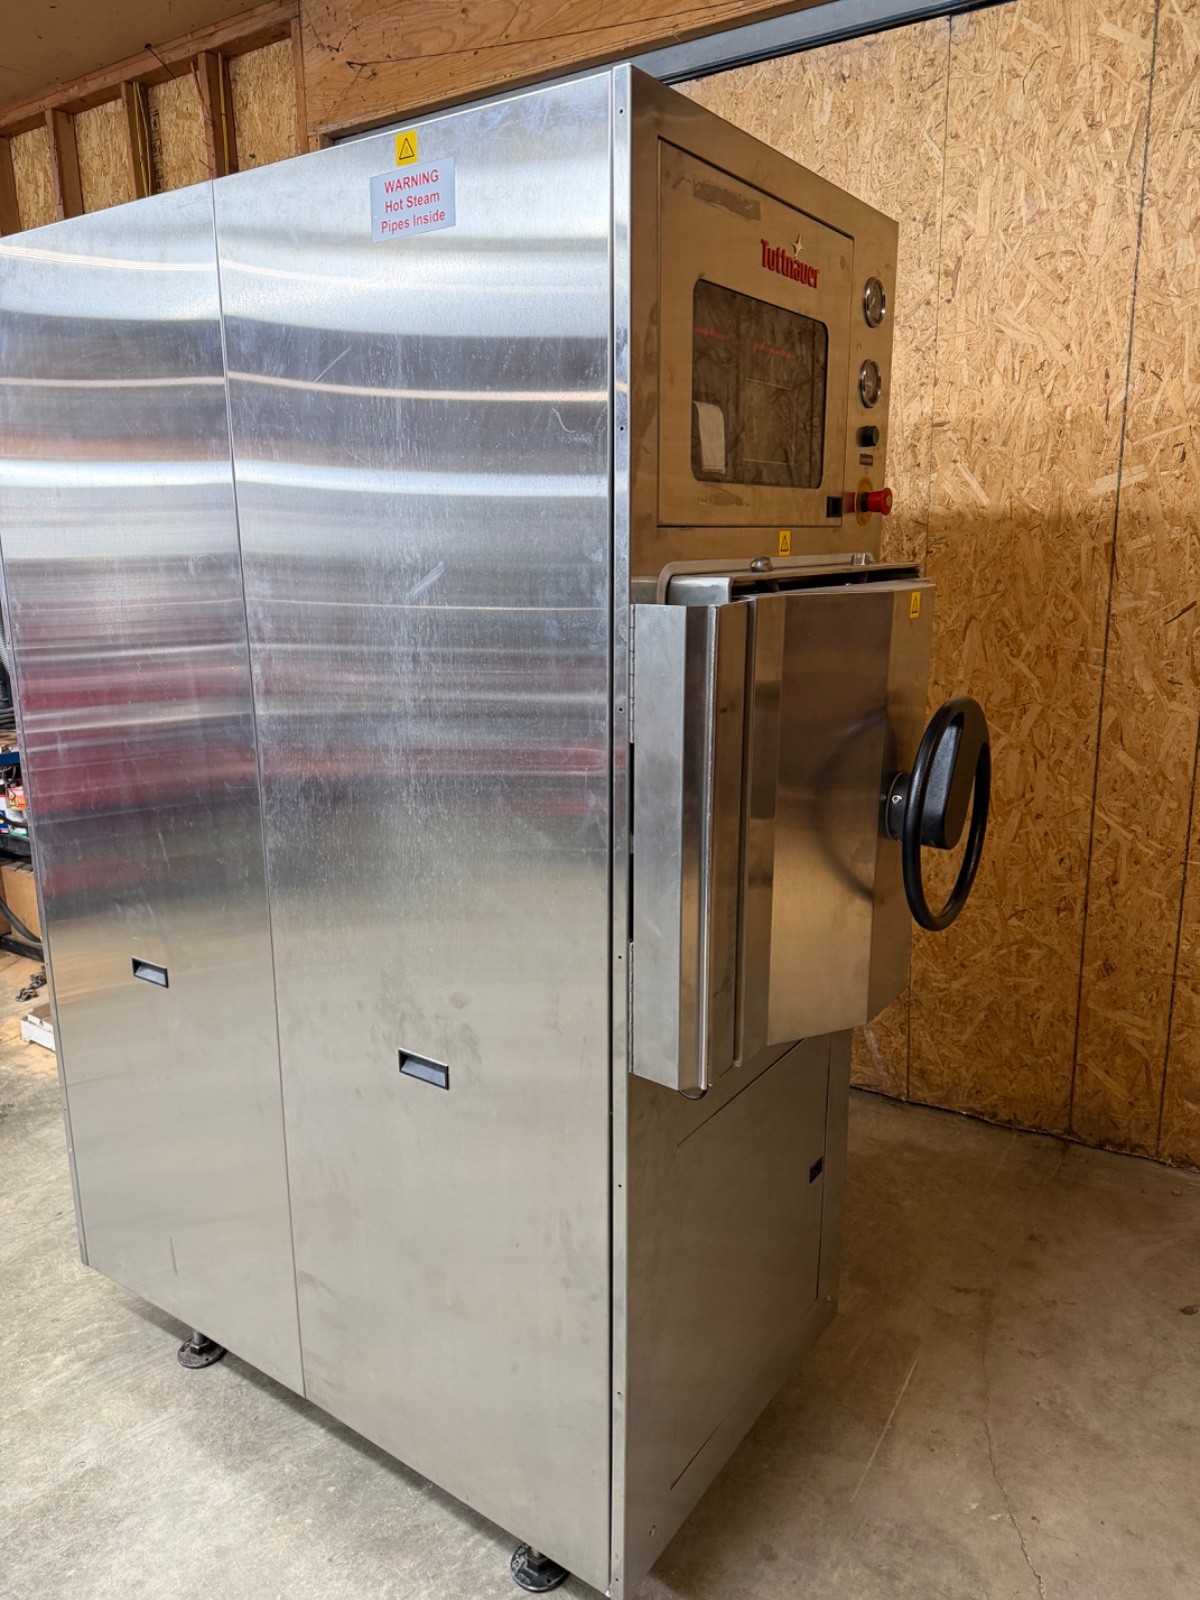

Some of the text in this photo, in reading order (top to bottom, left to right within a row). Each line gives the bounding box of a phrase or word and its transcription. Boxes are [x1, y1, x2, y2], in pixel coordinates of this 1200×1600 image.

[384, 169, 439, 194] WARNING
[385, 192, 440, 213] Hot Steam
[381, 210, 446, 234] Pipes Inside
[760, 238, 820, 289] Tuttnauer
